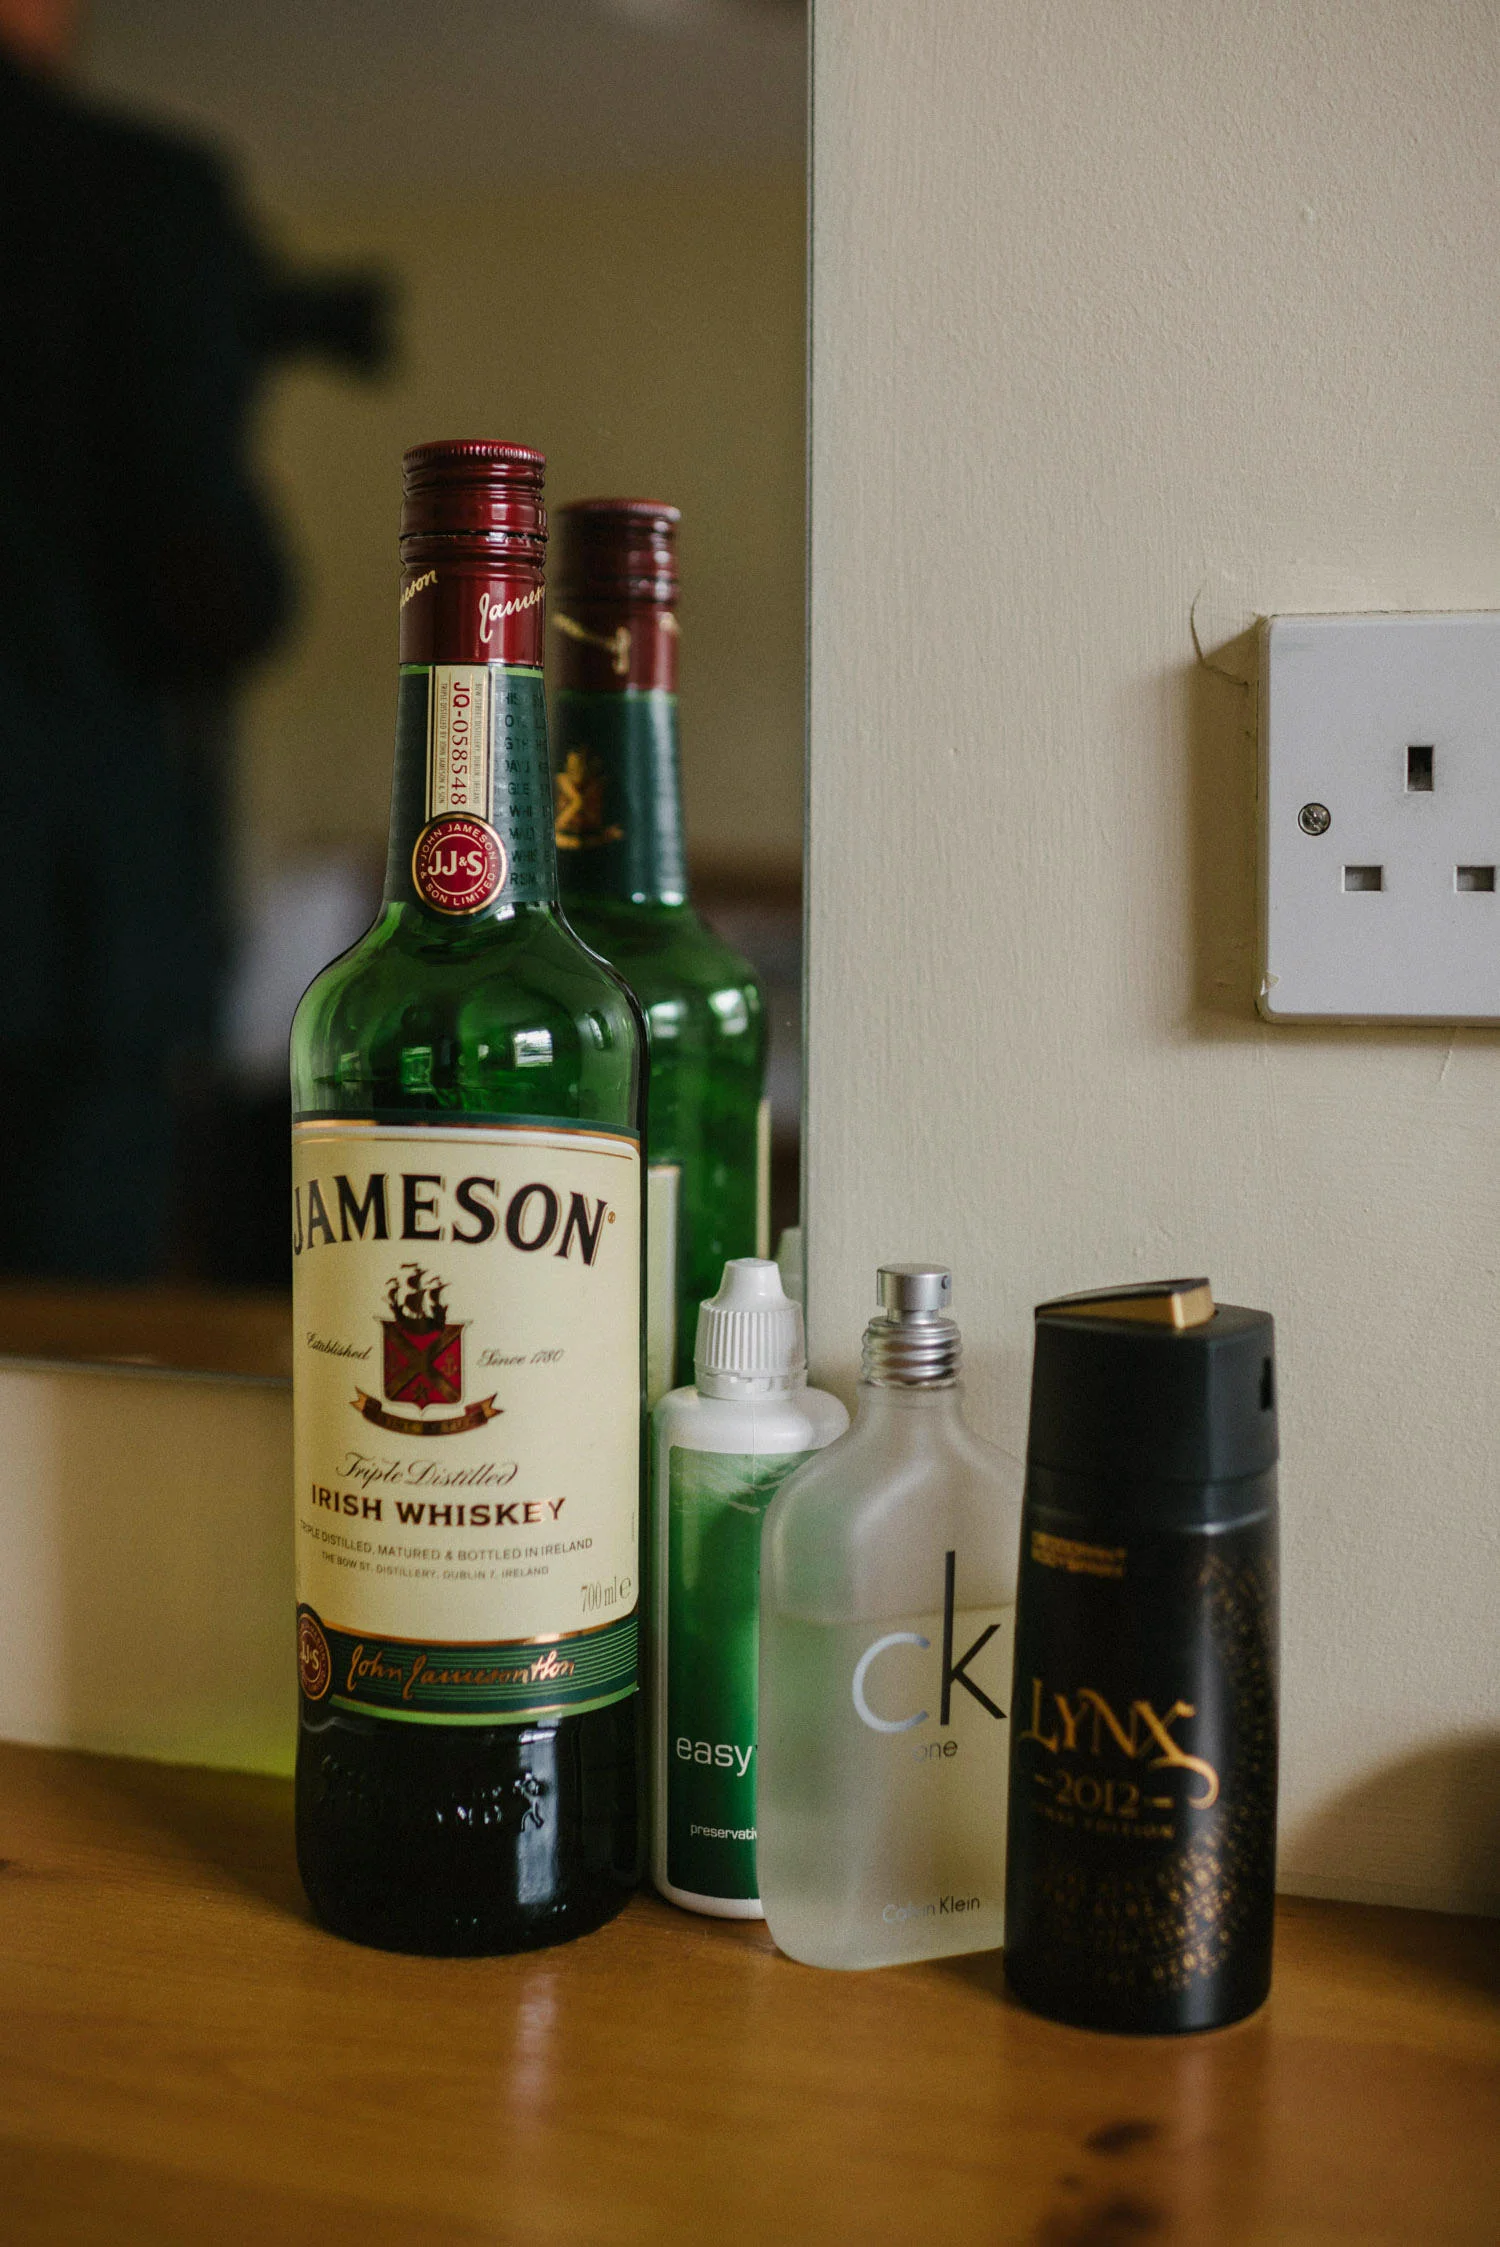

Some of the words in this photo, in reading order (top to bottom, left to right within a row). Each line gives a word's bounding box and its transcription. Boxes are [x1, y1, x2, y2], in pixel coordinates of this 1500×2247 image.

[440, 683, 448, 701] TRIPLE
[439, 703, 447, 730] DISTILLED
[450, 682, 471, 805] JQ-058548
[438, 757, 446, 783] JAMESON
[421, 828, 442, 860] JOHN
[447, 823, 497, 860] JAMESON
[427, 850, 483, 877] JJ&S
[426, 883, 448, 904] SON
[453, 872, 496, 906] LIMITED
[293, 1172, 608, 1267] JAMESON
[306, 1331, 373, 1361] Established
[477, 1349, 525, 1368] Since
[529, 1349, 565, 1365] 1780
[336, 1451, 403, 1490] Triple
[405, 1458, 519, 1488] Distilled
[311, 1483, 383, 1522] IRISH
[395, 1497, 567, 1528] WHISKEY
[322, 1551, 334, 1564] THE
[336, 1556, 358, 1569] BOW
[443, 1568, 486, 1581] DUBLIN
[501, 1565, 550, 1579] IRELAND
[377, 1543, 441, 1561] MATURED
[444, 1549, 453, 1562] &
[458, 1547, 521, 1562] BOTTLED
[524, 1543, 538, 1558] IN
[541, 1537, 593, 1557] IRELAND
[581, 1582, 602, 1613] 700
[604, 1575, 617, 1607] ml
[852, 1550, 1008, 1734] ck
[347, 1643, 402, 1692] John
[403, 1653, 529, 1701] Jameson
[676, 1737, 753, 1777] easy
[911, 1740, 958, 1763] one
[1019, 1676, 1220, 1811] LYNX
[939, 1895, 980, 1915] Klein
